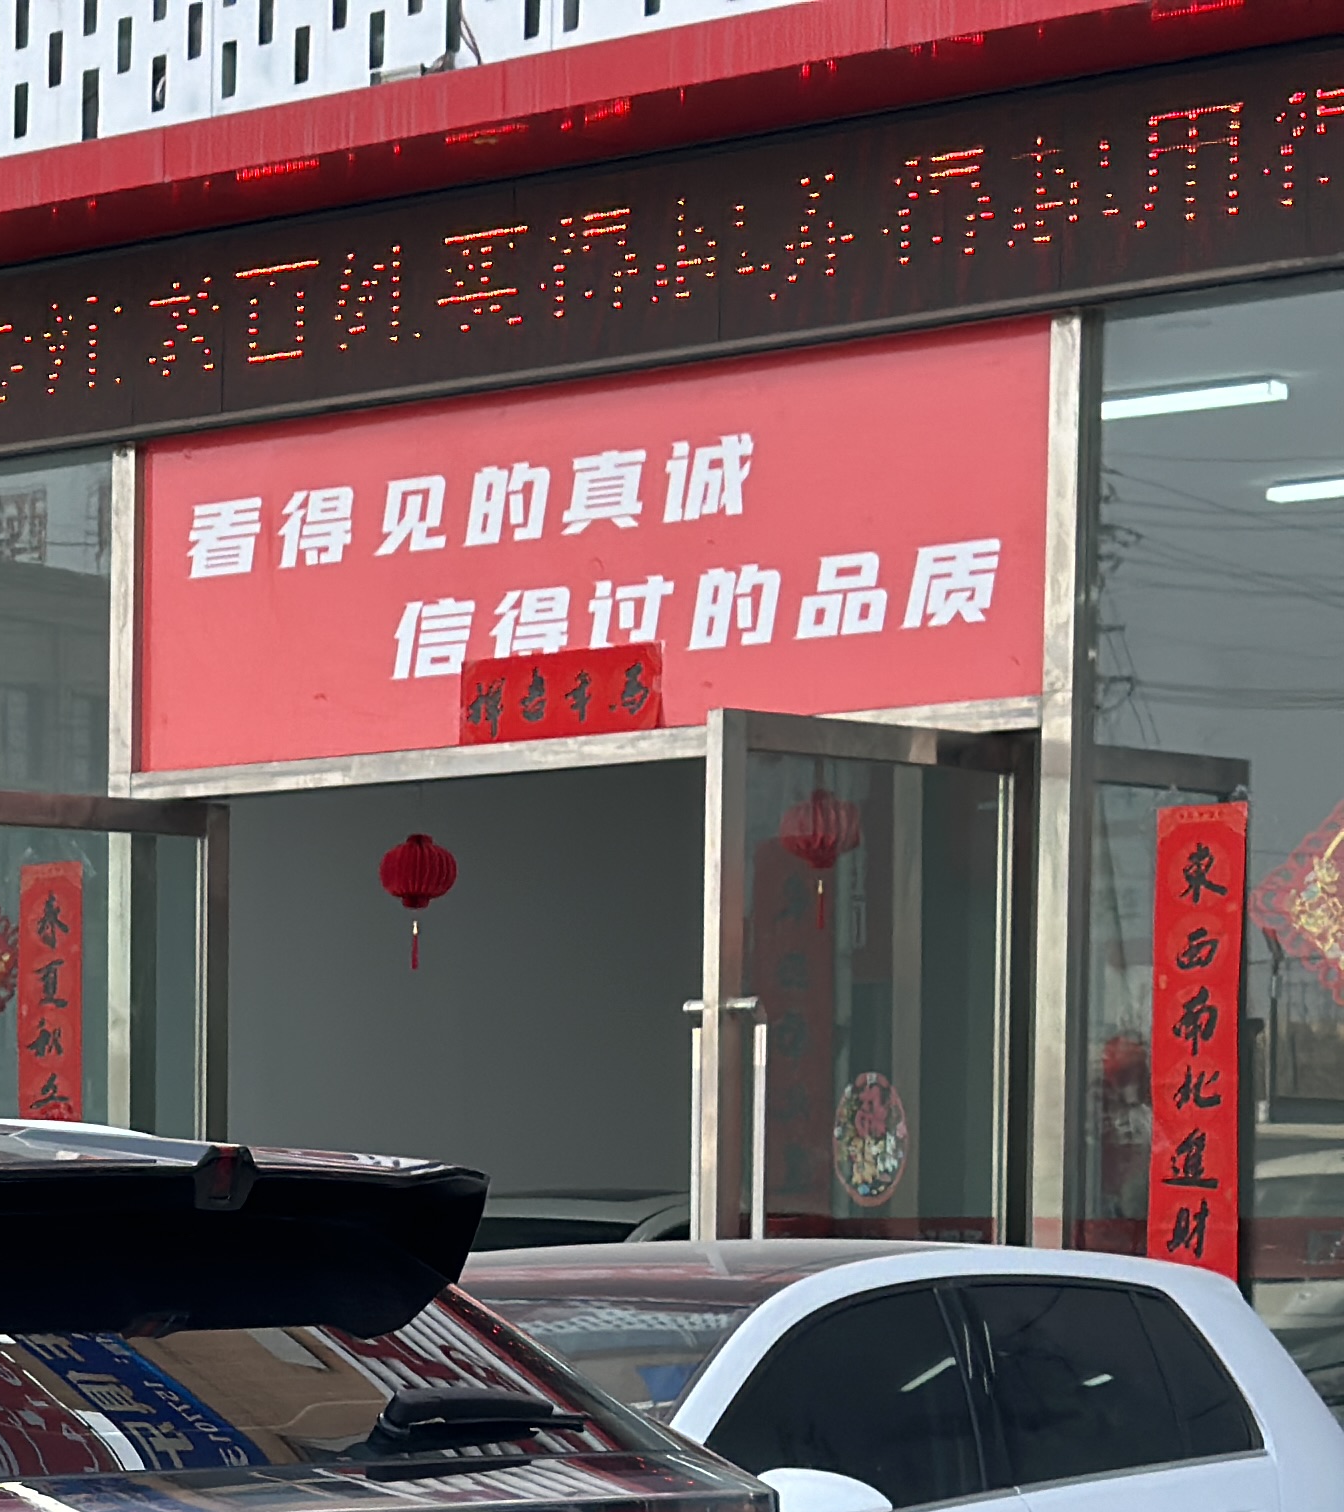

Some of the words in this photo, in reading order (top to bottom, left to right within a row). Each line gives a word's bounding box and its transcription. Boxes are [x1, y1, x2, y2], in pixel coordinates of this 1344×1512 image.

[186, 433, 754, 580] 看得见的真诚
[391, 538, 1002, 680] 信得过的品质
